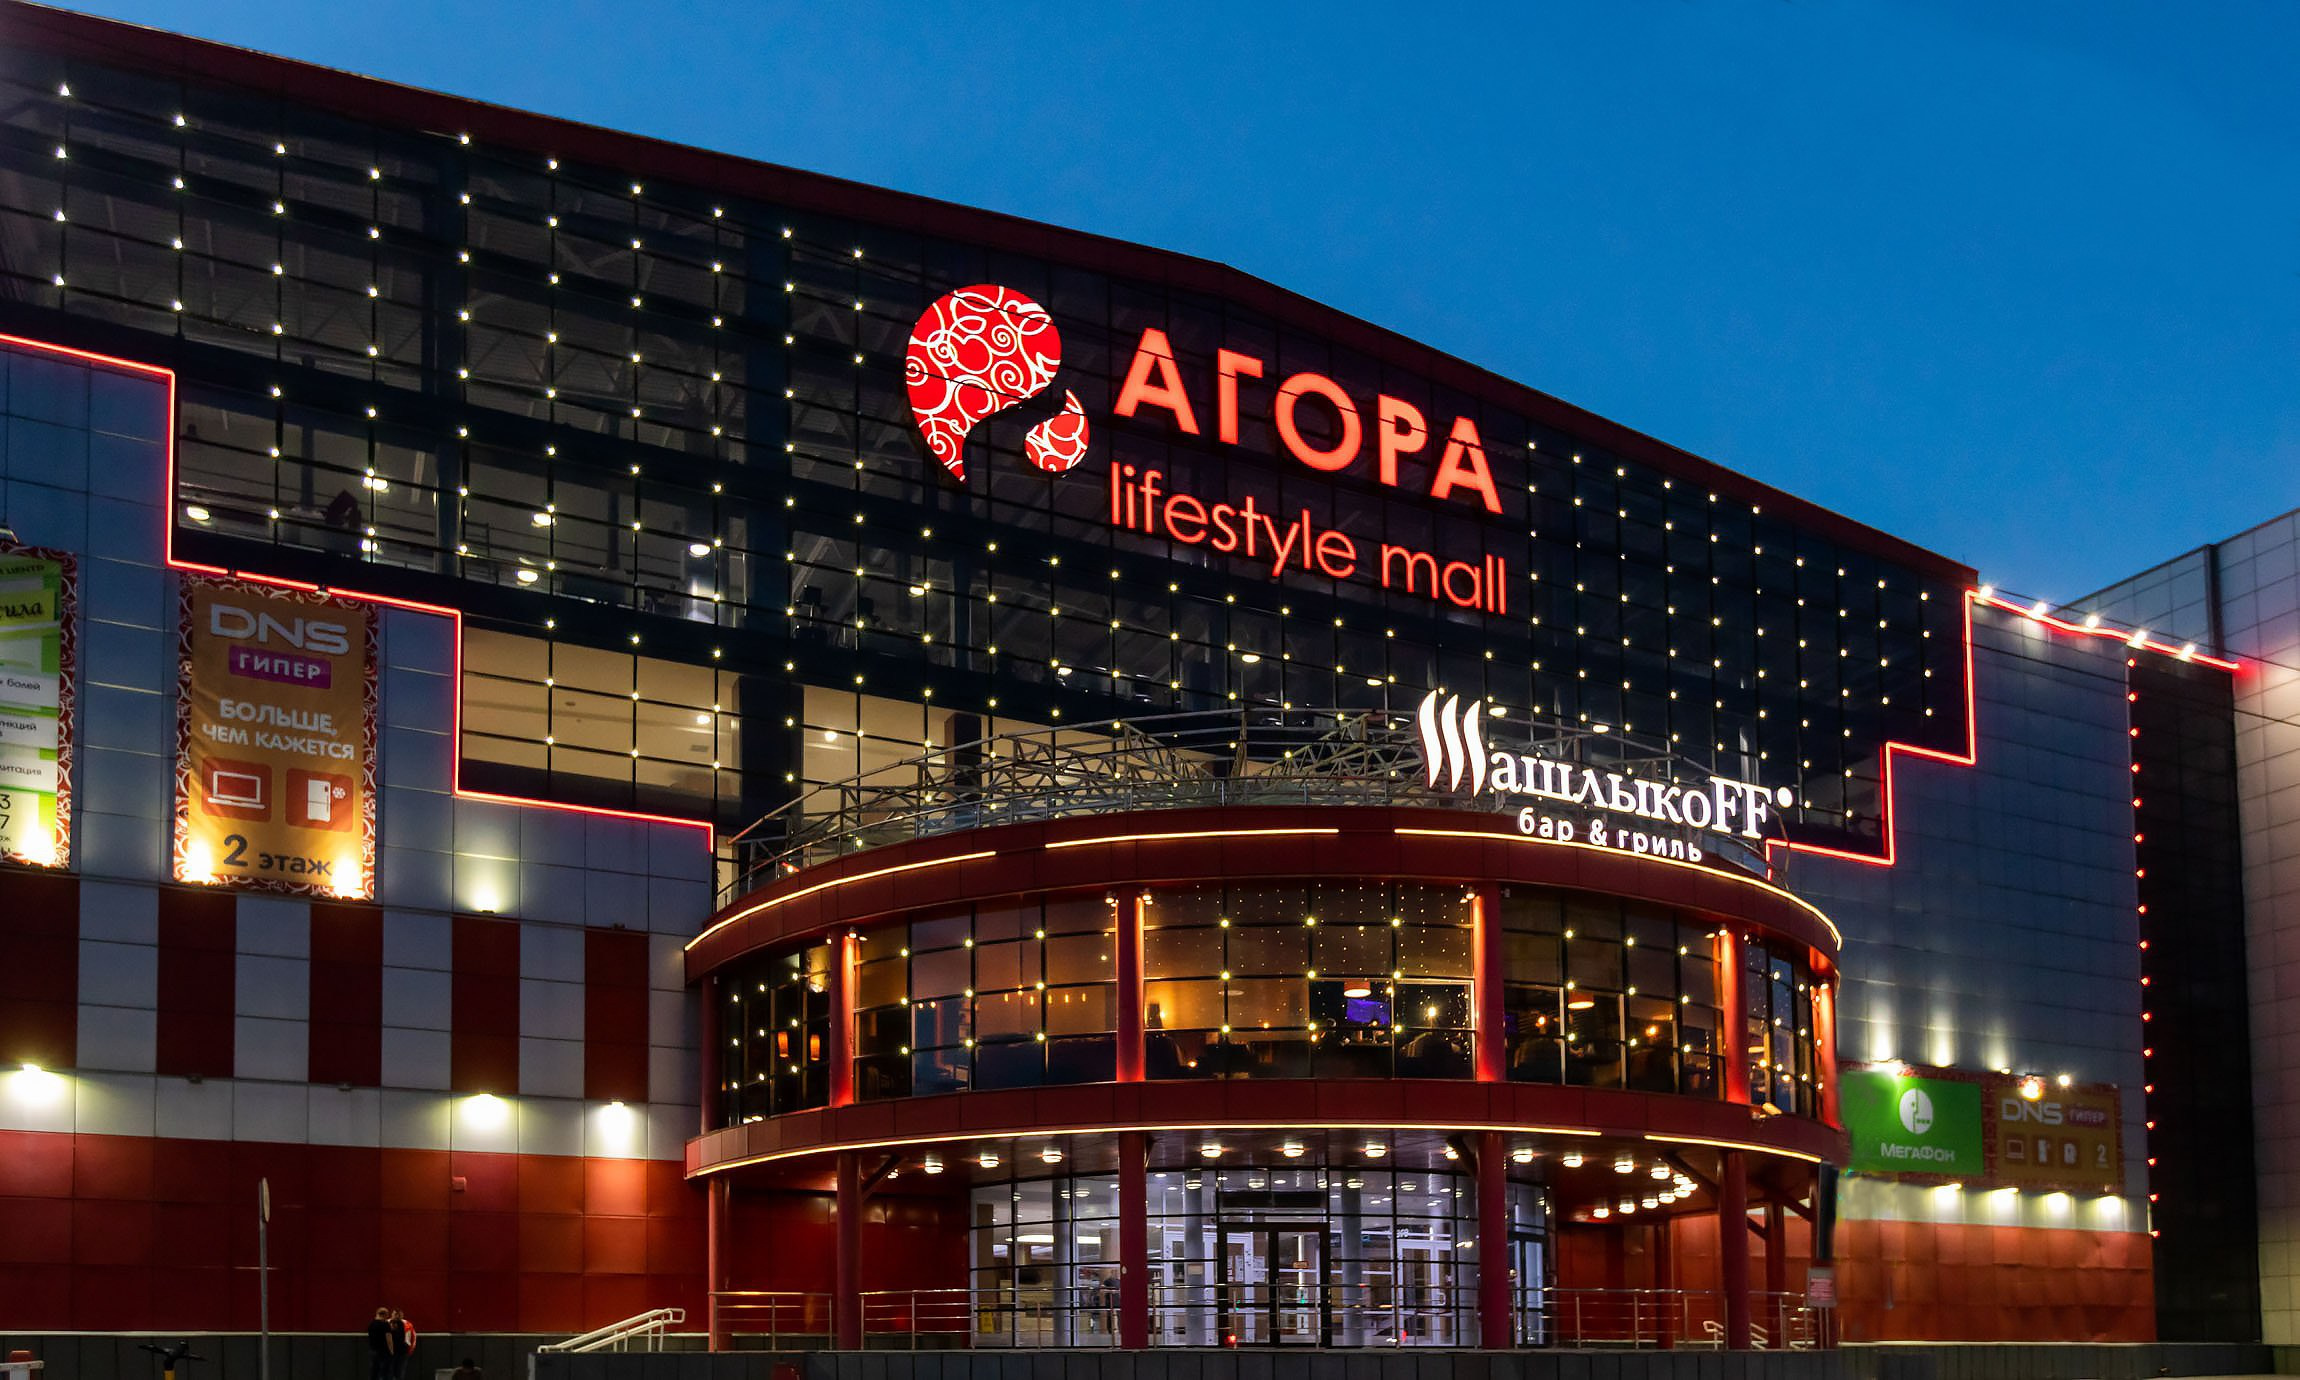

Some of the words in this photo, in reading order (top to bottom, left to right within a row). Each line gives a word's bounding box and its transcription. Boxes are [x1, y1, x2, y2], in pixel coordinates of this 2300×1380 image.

[1113, 327, 1504, 514] АГОРА
[1111, 462, 1356, 577] lifestyle
[1382, 541, 1507, 615] mall
[210, 604, 350, 656] DNS
[239, 653, 321, 680] ГИПЕР
[220, 699, 338, 736] БОЛЬШЕ,
[202, 723, 248, 746] ЧЕМ
[255, 732, 355, 760] КАЖЕТСЯ
[1518, 807, 1574, 842] бар
[1590, 820, 1608, 847] &
[1618, 829, 1702, 863] гриль
[223, 834, 249, 867] 2
[258, 852, 331, 876] этаж
[2001, 1098, 2064, 1126] DNS
[2096, 1144, 2106, 1162] 2
